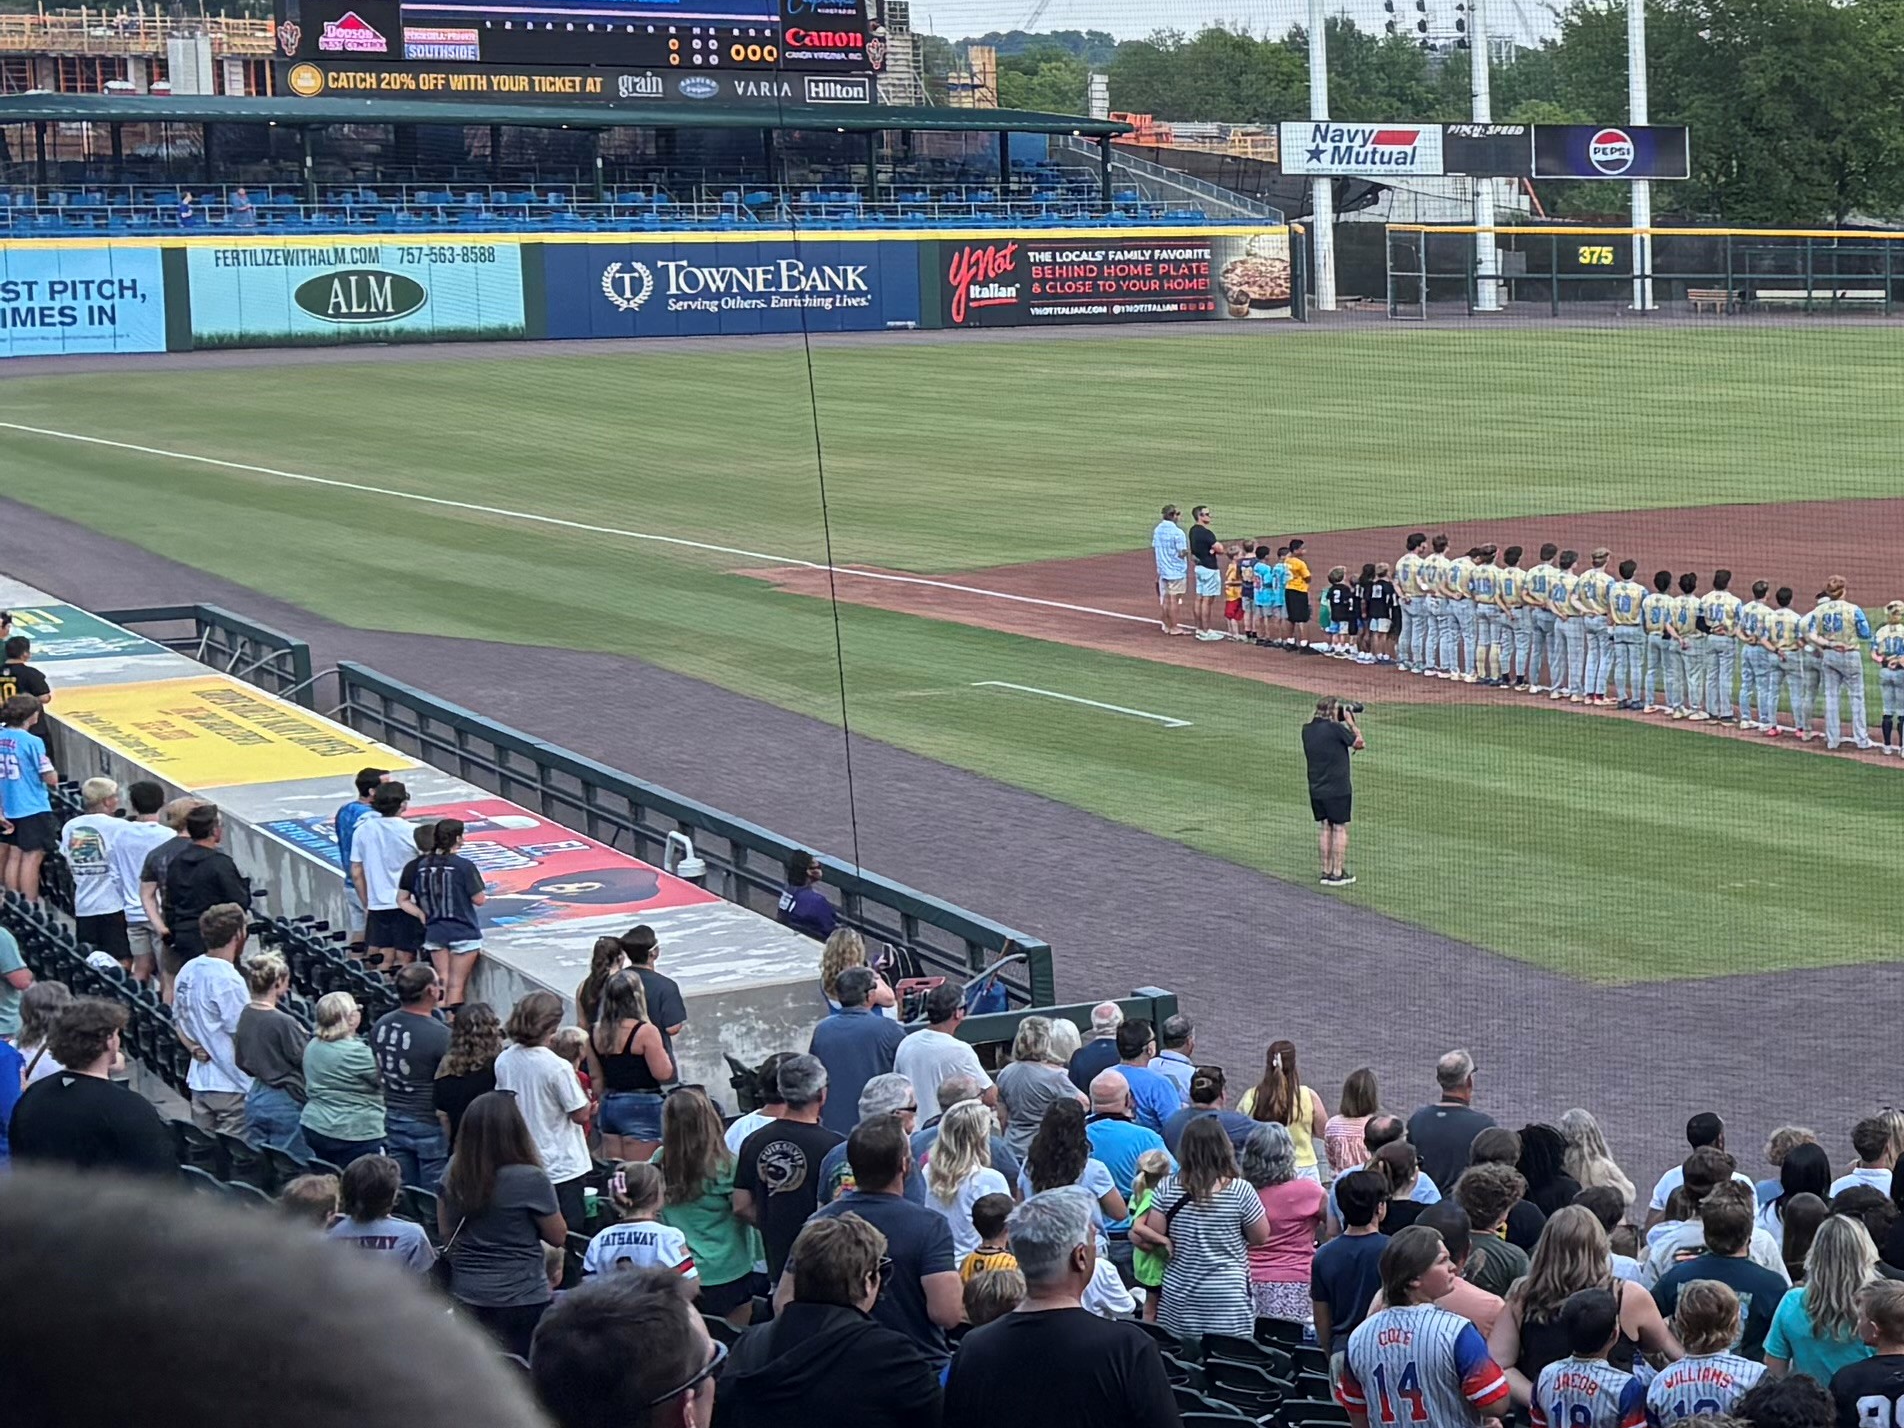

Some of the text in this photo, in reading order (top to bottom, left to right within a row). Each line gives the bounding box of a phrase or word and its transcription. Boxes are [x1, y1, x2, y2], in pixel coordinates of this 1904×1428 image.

[785, 27, 863, 47] Canon
[408, 44, 476, 59] SOUTHSIDE
[328, 71, 603, 93] CATCH 20% OFF WITH YOUR TICKET AT
[618, 72, 663, 98] grain
[734, 81, 792, 97] VARIA
[809, 81, 864, 99] Hilton
[1311, 124, 1376, 147] Navy
[1447, 124, 1525, 137] PITCH SPEED
[1330, 145, 1417, 166] Mutual
[1593, 146, 1631, 157] PEPSI
[214, 245, 497, 268] FERTILIZEWITHALM.COM 757-563-8588
[1028, 249, 1211, 263] THE LOCALS' FAMILY FAVORITE
[1579, 246, 1614, 265] 375
[1031, 262, 1209, 279] BEHIND HOME PLATE
[50, 278, 147, 303] PITCH,
[328, 275, 396, 315] ALM
[970, 283, 1018, 299] Italian
[1031, 281, 1041, 294] &
[1045, 281, 1093, 293] CLOSE
[1097, 281, 1115, 292] TO
[1119, 280, 1160, 291] YOUR
[668, 295, 833, 313] Serving Others. Enriching
[88, 304, 117, 327] IN
[1552, 1370, 1597, 1396] JACOB
[1663, 1369, 1734, 1390] WILLIAMS
[1373, 1361, 1429, 1424] 14
